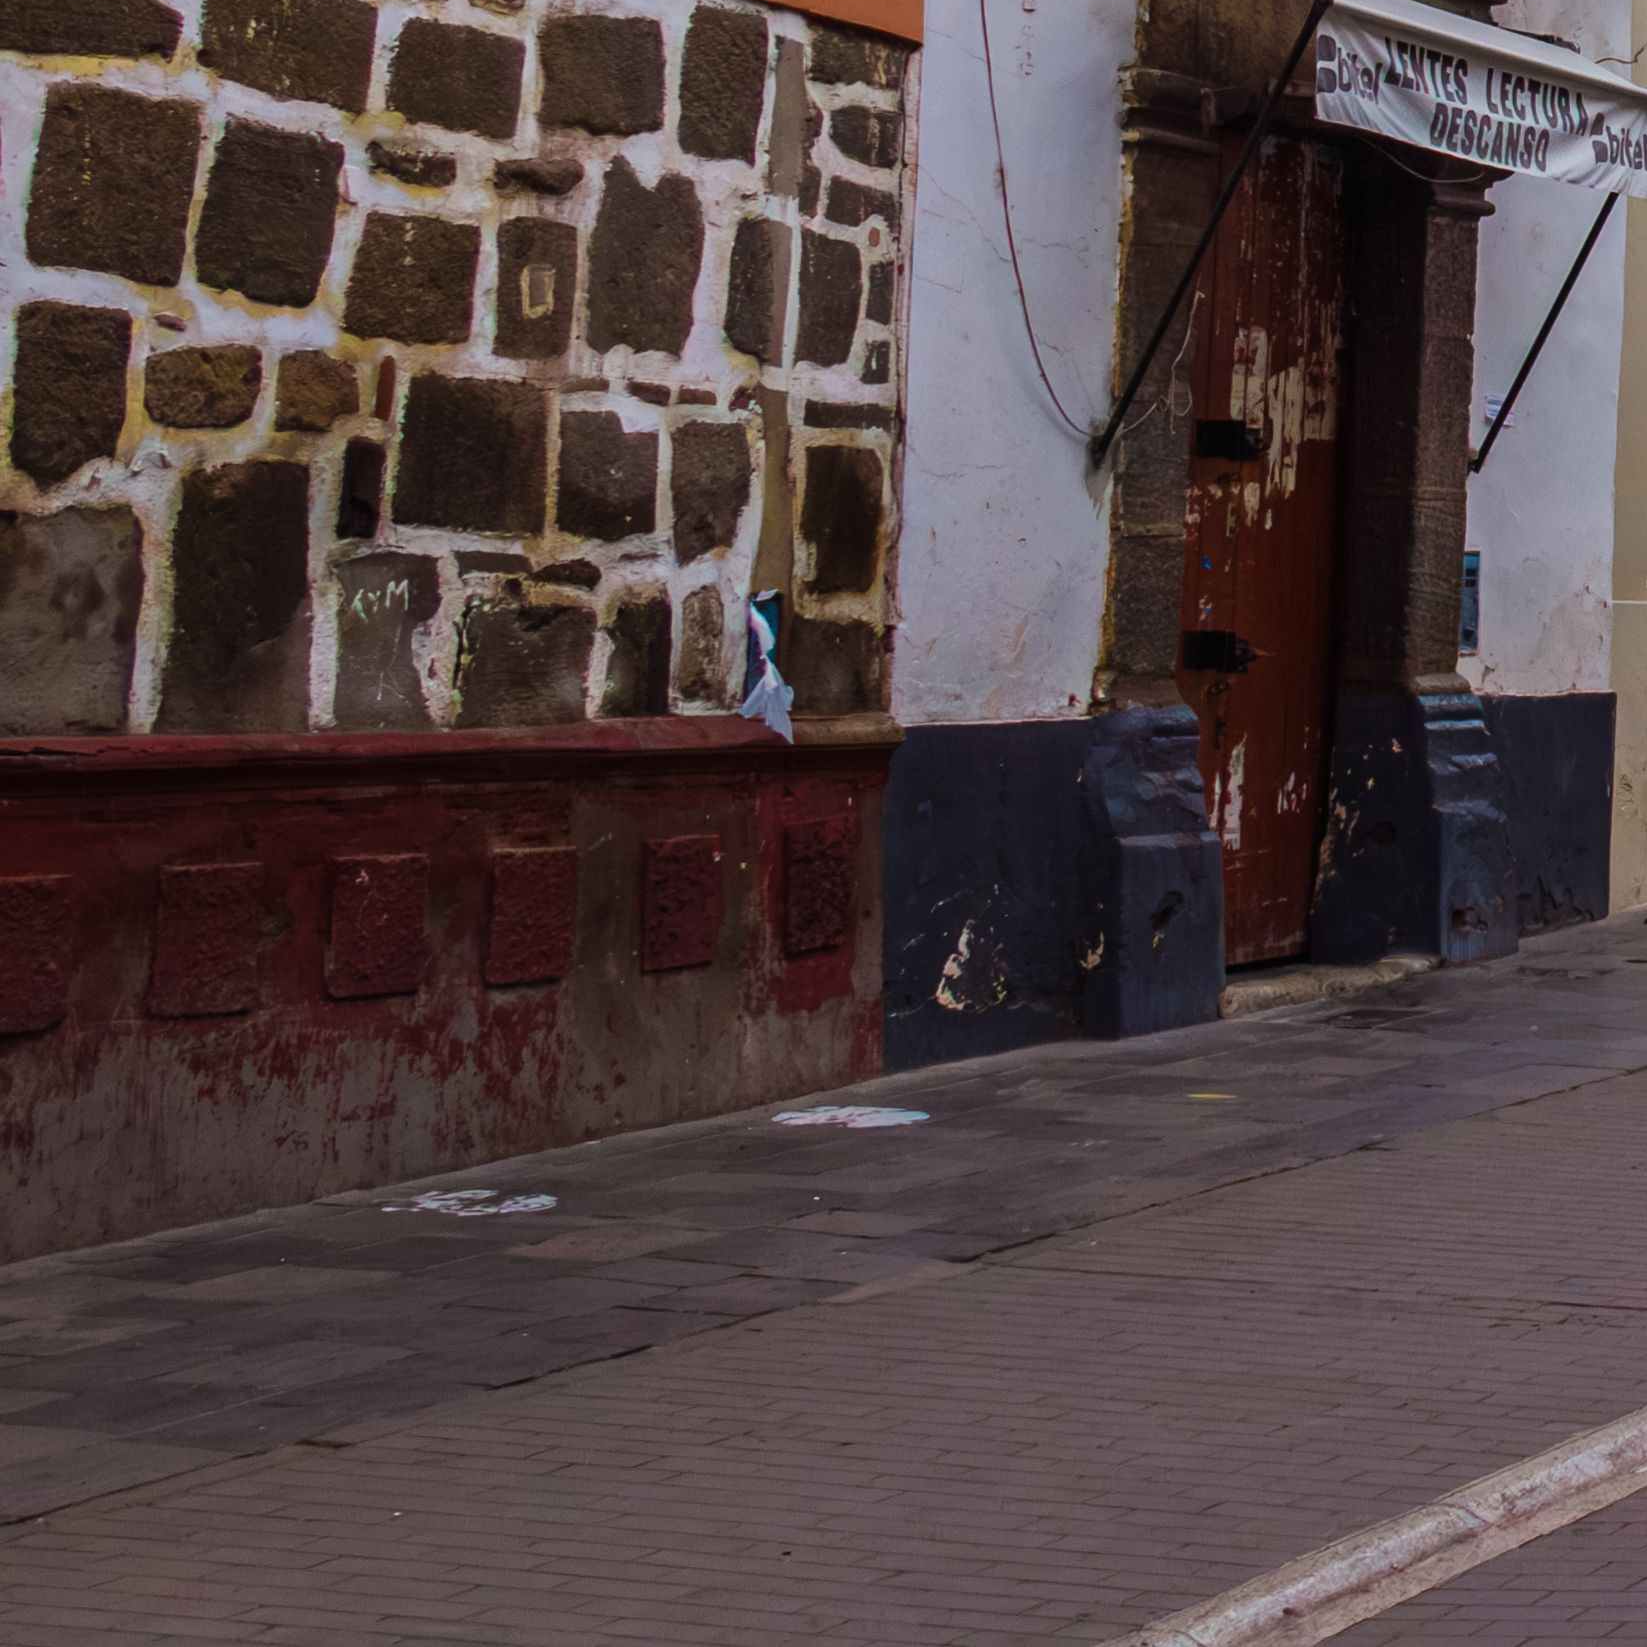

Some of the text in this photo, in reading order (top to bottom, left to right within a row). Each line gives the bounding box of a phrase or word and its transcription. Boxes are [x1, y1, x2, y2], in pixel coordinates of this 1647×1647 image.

[1384, 36, 1589, 137] LENTES LECTURA
[1429, 102, 1549, 172] DESCANSO
